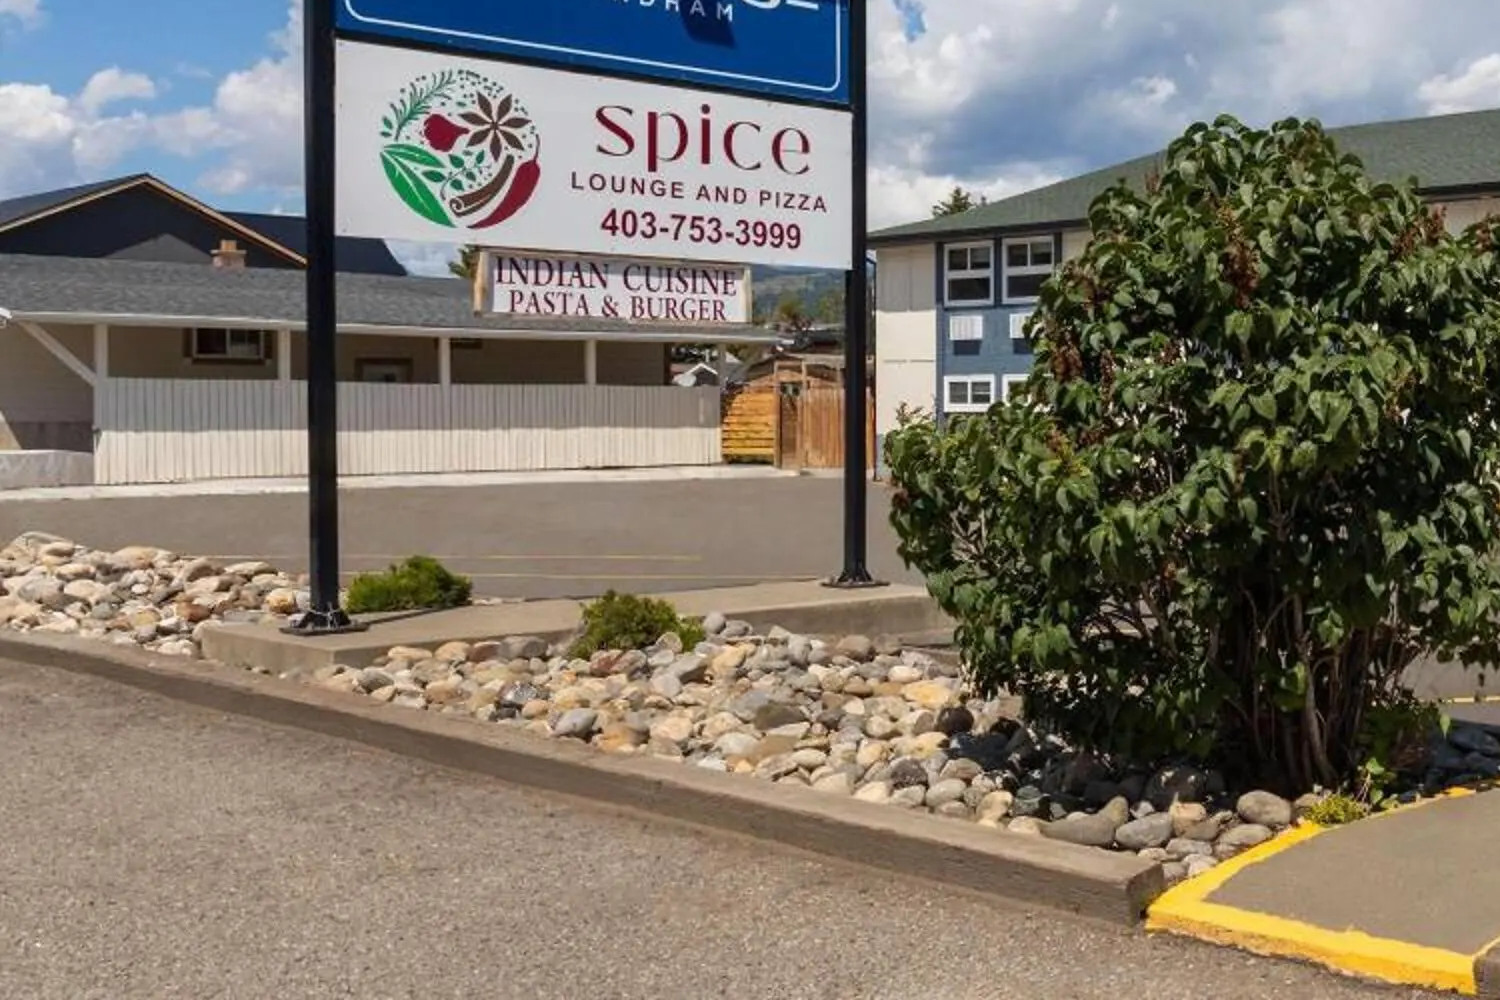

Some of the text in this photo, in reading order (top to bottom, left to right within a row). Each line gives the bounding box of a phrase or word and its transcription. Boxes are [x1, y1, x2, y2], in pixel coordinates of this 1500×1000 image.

[571, 171, 827, 213] LOUNGE AND PIZZA
[601, 208, 801, 249] 403-753-3999
[496, 256, 737, 296] INDIAN CUISINE
[509, 289, 727, 321] PASTA & BURGER
